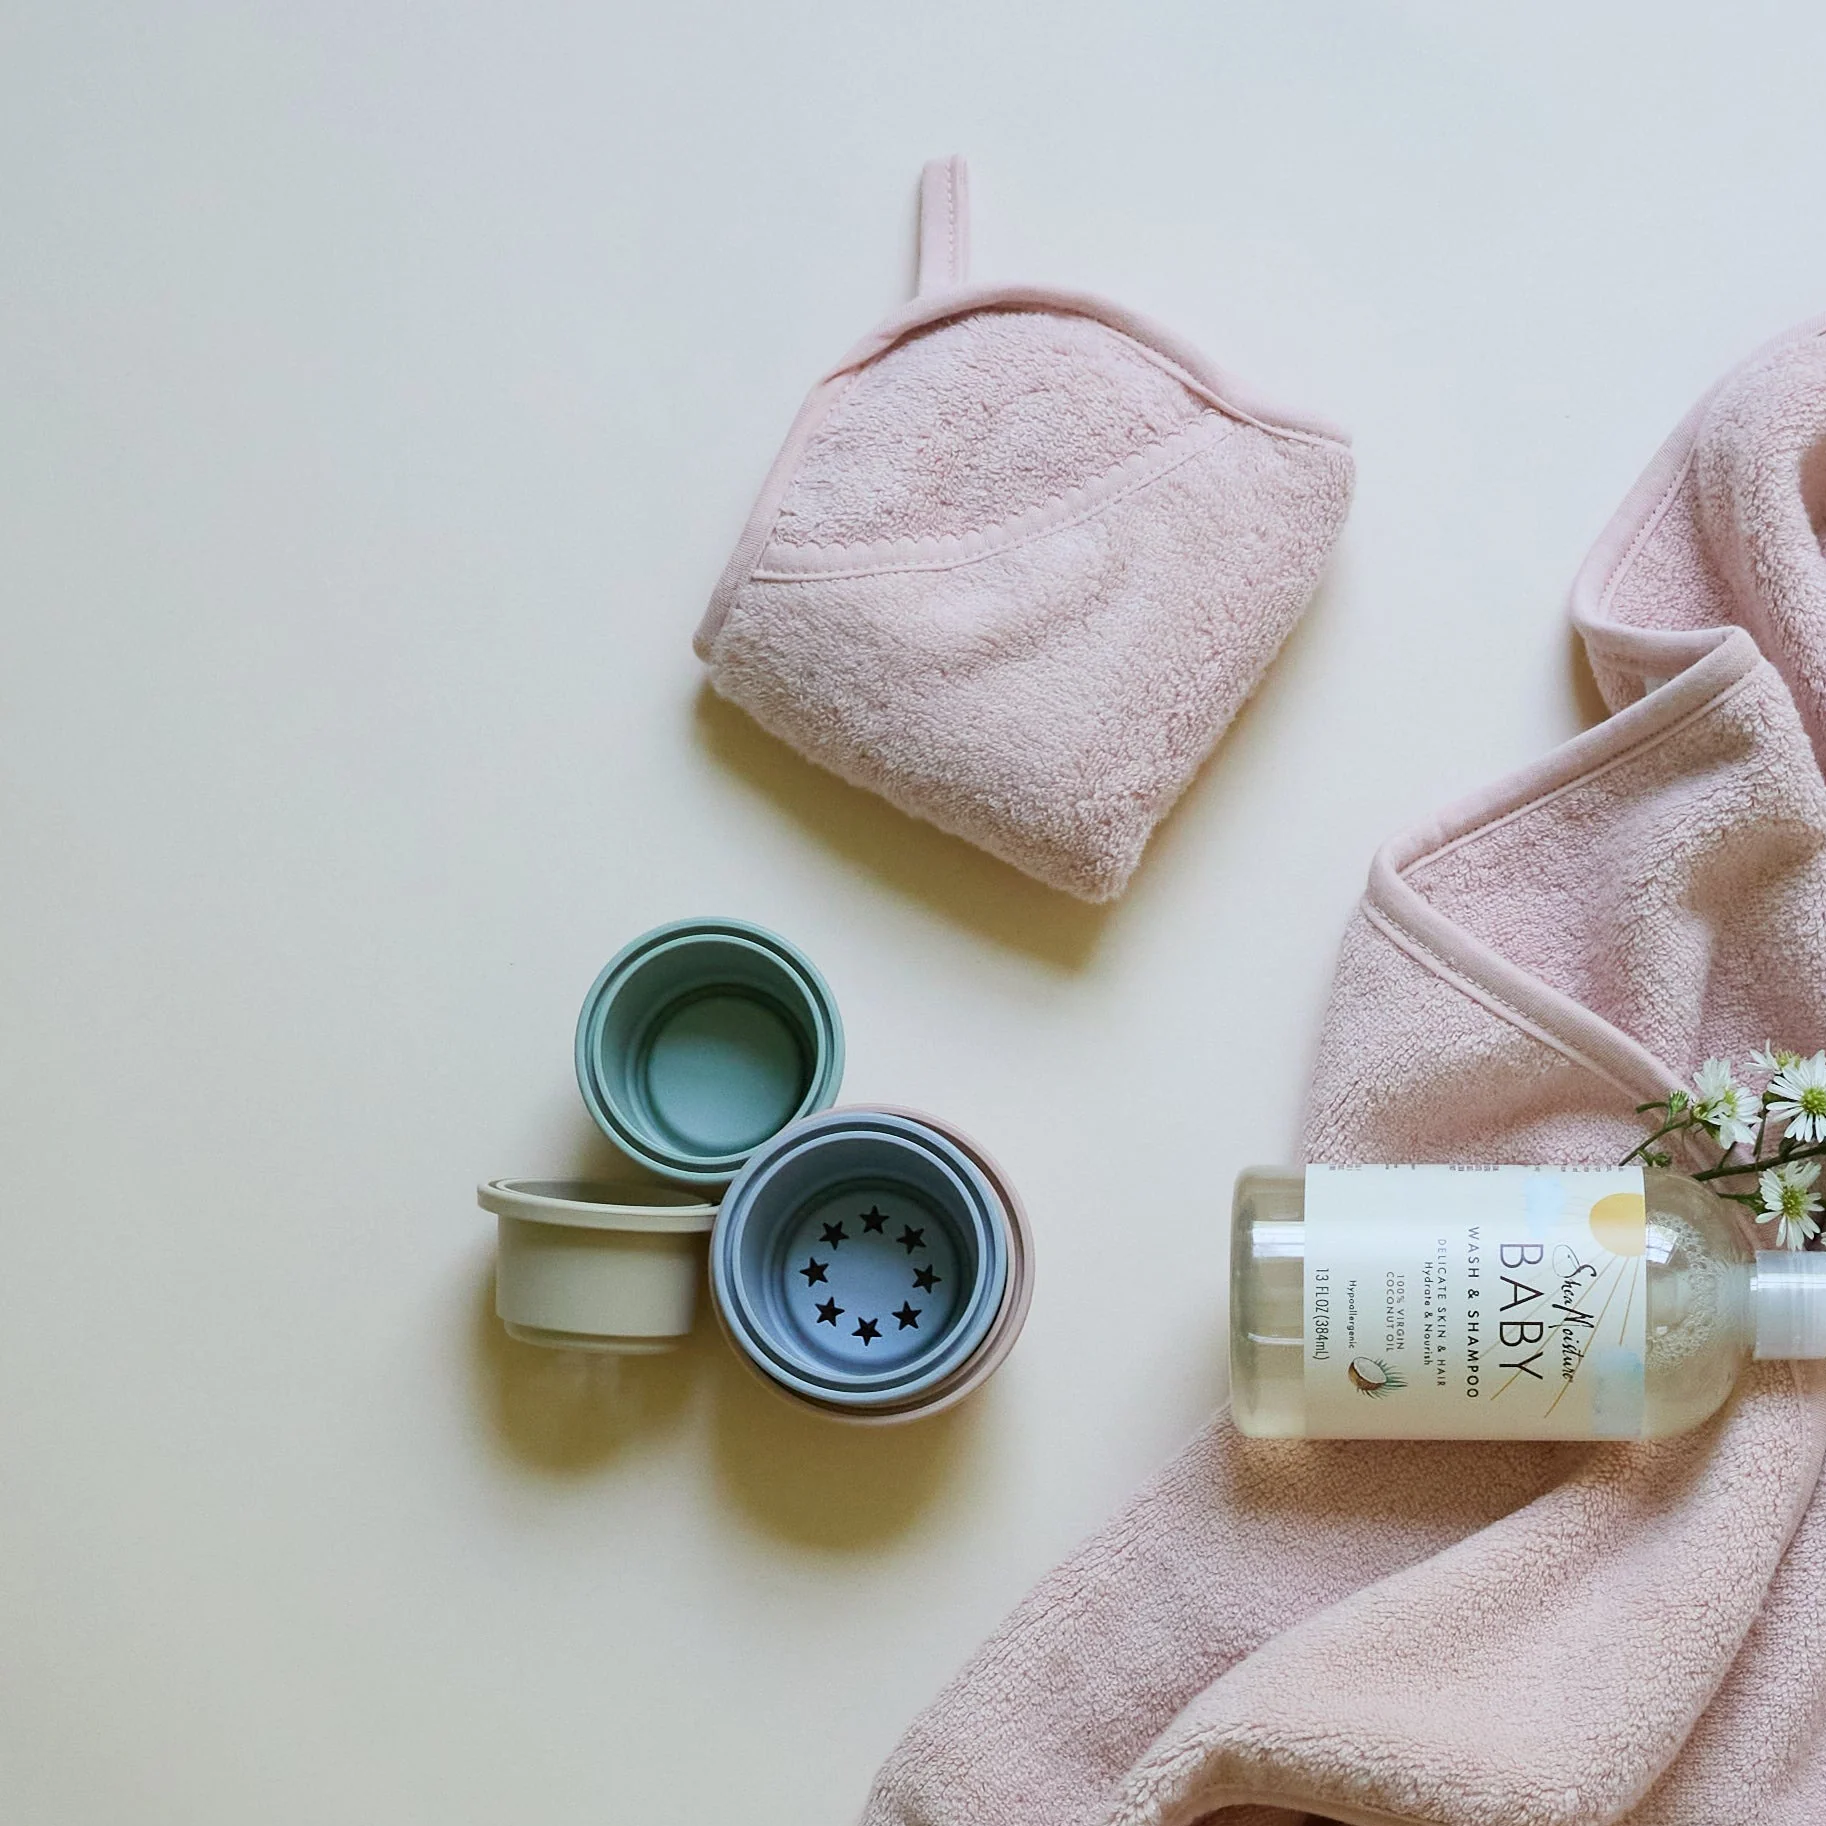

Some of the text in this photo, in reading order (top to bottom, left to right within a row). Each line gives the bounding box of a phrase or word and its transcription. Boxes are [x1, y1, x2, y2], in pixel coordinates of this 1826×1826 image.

[1315, 1267, 1330, 1282] 13
[1346, 1279, 1358, 1350] Hypoallergenic
[1385, 1271, 1395, 1353] COCONUT OIL
[1396, 1274, 1405, 1351] 100% VIRGIN
[1421, 1261, 1434, 1366] Hydrate & Nourish
[1436, 1238, 1447, 1387] DELICATE SKIN & HAIR
[1466, 1226, 1480, 1399] WASH & SHAMPOO
[1498, 1242, 1545, 1381] BABY
[1312, 1314, 1330, 1361] (384mL)
